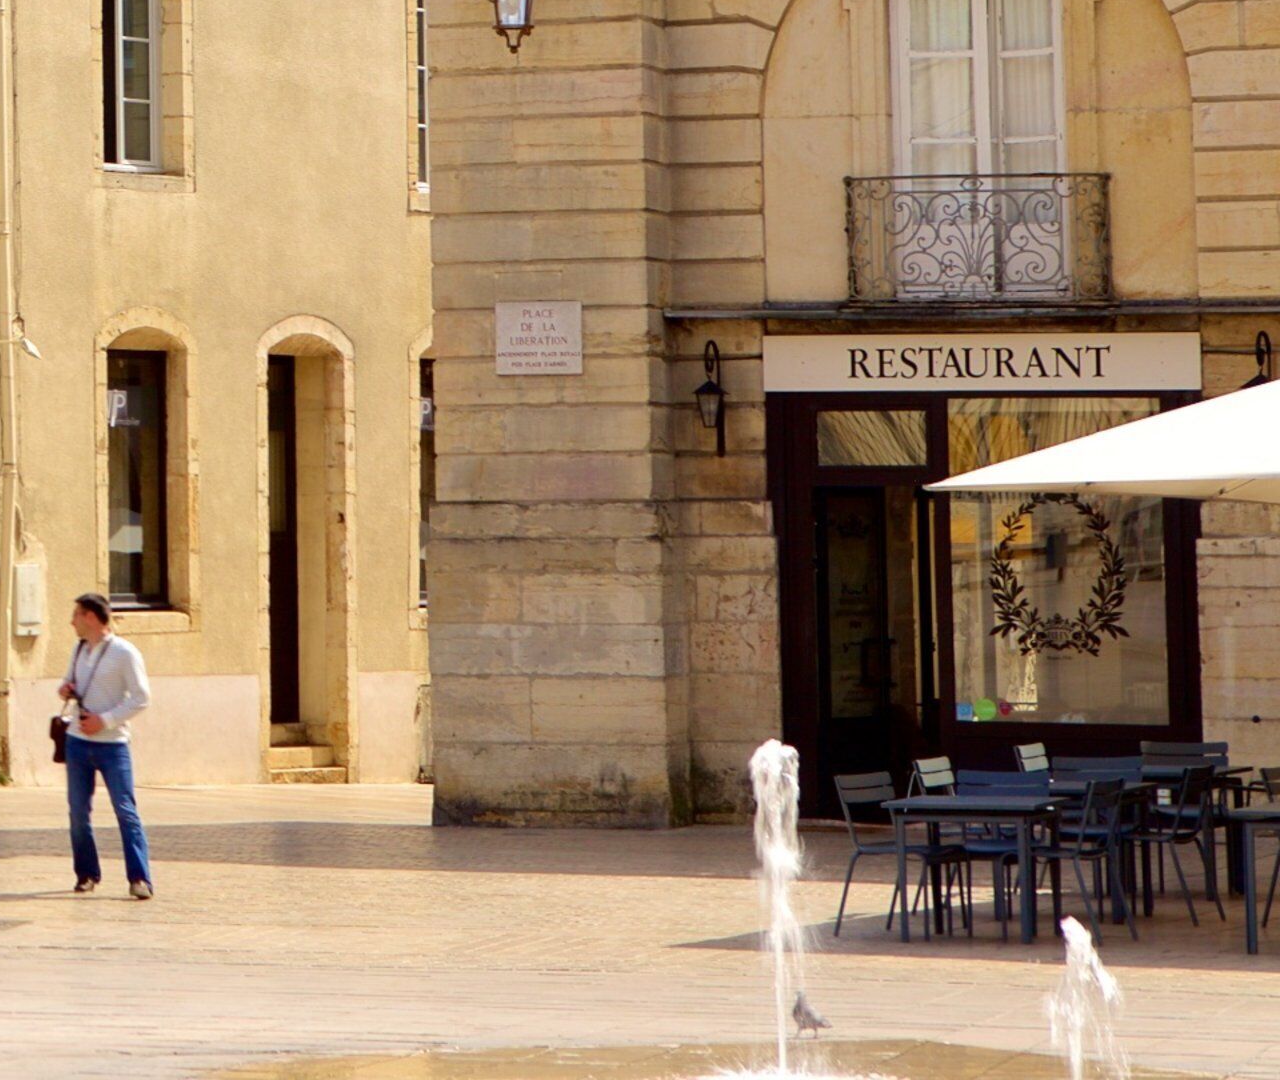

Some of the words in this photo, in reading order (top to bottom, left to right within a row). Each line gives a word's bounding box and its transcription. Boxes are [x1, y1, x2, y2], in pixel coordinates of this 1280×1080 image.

[522, 308, 554, 319] PLACE
[520, 321, 534, 332] DE
[542, 321, 557, 332] LA
[509, 335, 569, 346] LIBERATION
[846, 344, 1112, 380] RESTAURANT
